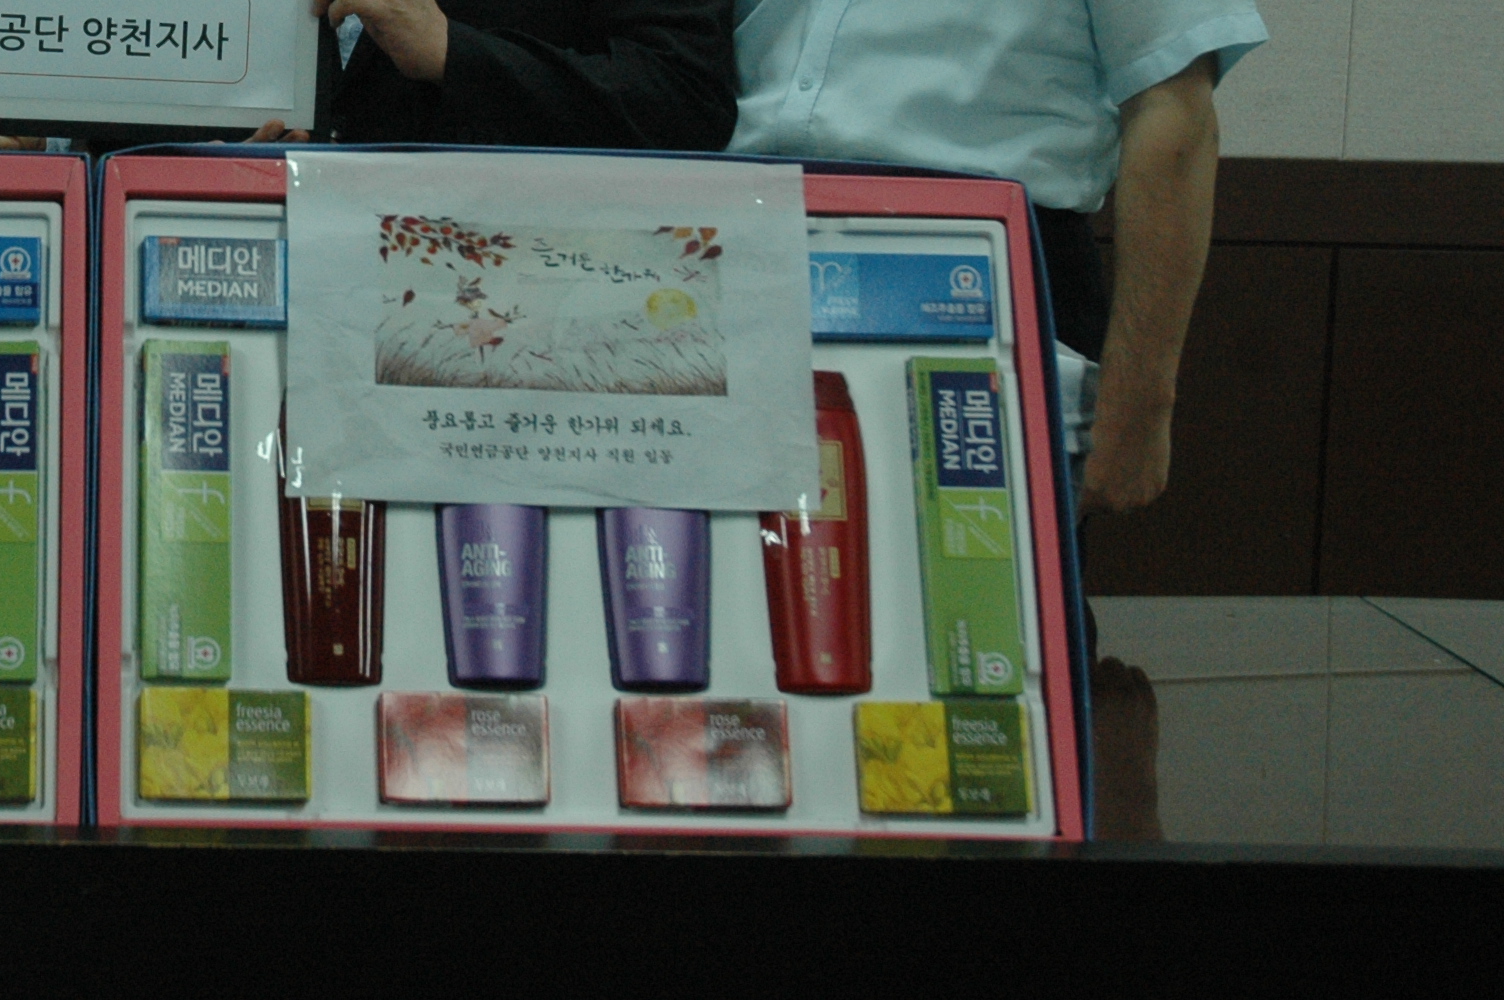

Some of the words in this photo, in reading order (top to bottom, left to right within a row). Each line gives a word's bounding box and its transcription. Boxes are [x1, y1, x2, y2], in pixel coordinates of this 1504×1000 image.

[82, 17, 230, 61] 양천지사
[177, 246, 261, 276] 메디안
[177, 279, 259, 299] MEDIAN
[0, 372, 30, 457] 메디안
[168, 372, 187, 454] MEDIAN
[192, 373, 223, 458] 메디안
[504, 411, 558, 434] 즐거운
[567, 414, 620, 436] 한가위
[937, 388, 962, 471] MEDIAN
[963, 388, 1000, 475] 메디안
[439, 442, 529, 462] 국민연금공단
[536, 445, 598, 464] 양천지사
[461, 543, 506, 560] ANTI-
[460, 559, 512, 577] AGING
[625, 561, 677, 579] AGING
[236, 703, 282, 719] freesia
[235, 717, 291, 733] essence
